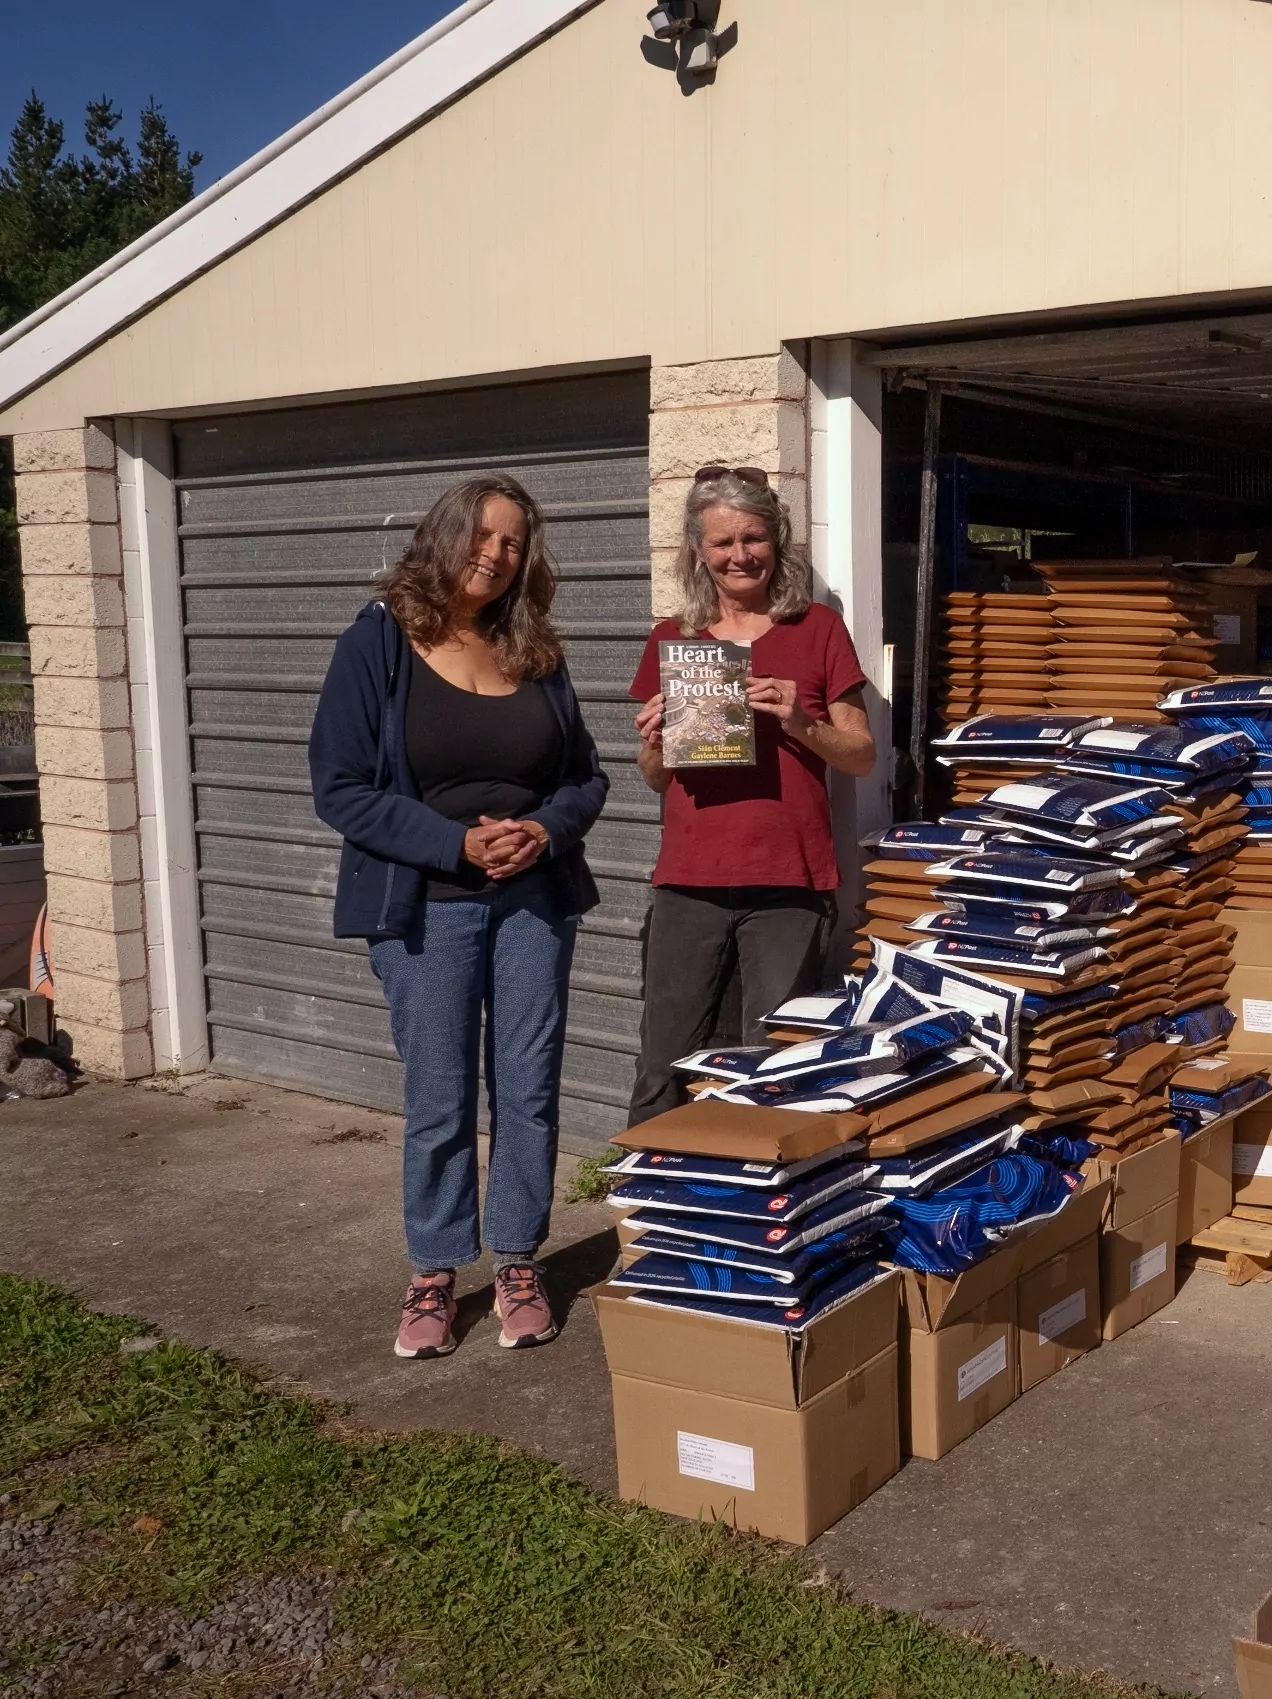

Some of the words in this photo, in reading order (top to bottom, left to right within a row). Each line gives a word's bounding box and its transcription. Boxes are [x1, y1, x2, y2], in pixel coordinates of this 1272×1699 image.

[667, 645, 725, 663] Heart
[681, 666, 697, 679] of
[698, 666, 722, 679] the
[668, 679, 741, 697] Protest
[691, 751, 718, 761] Gaylene
[718, 751, 741, 759] Barnes
